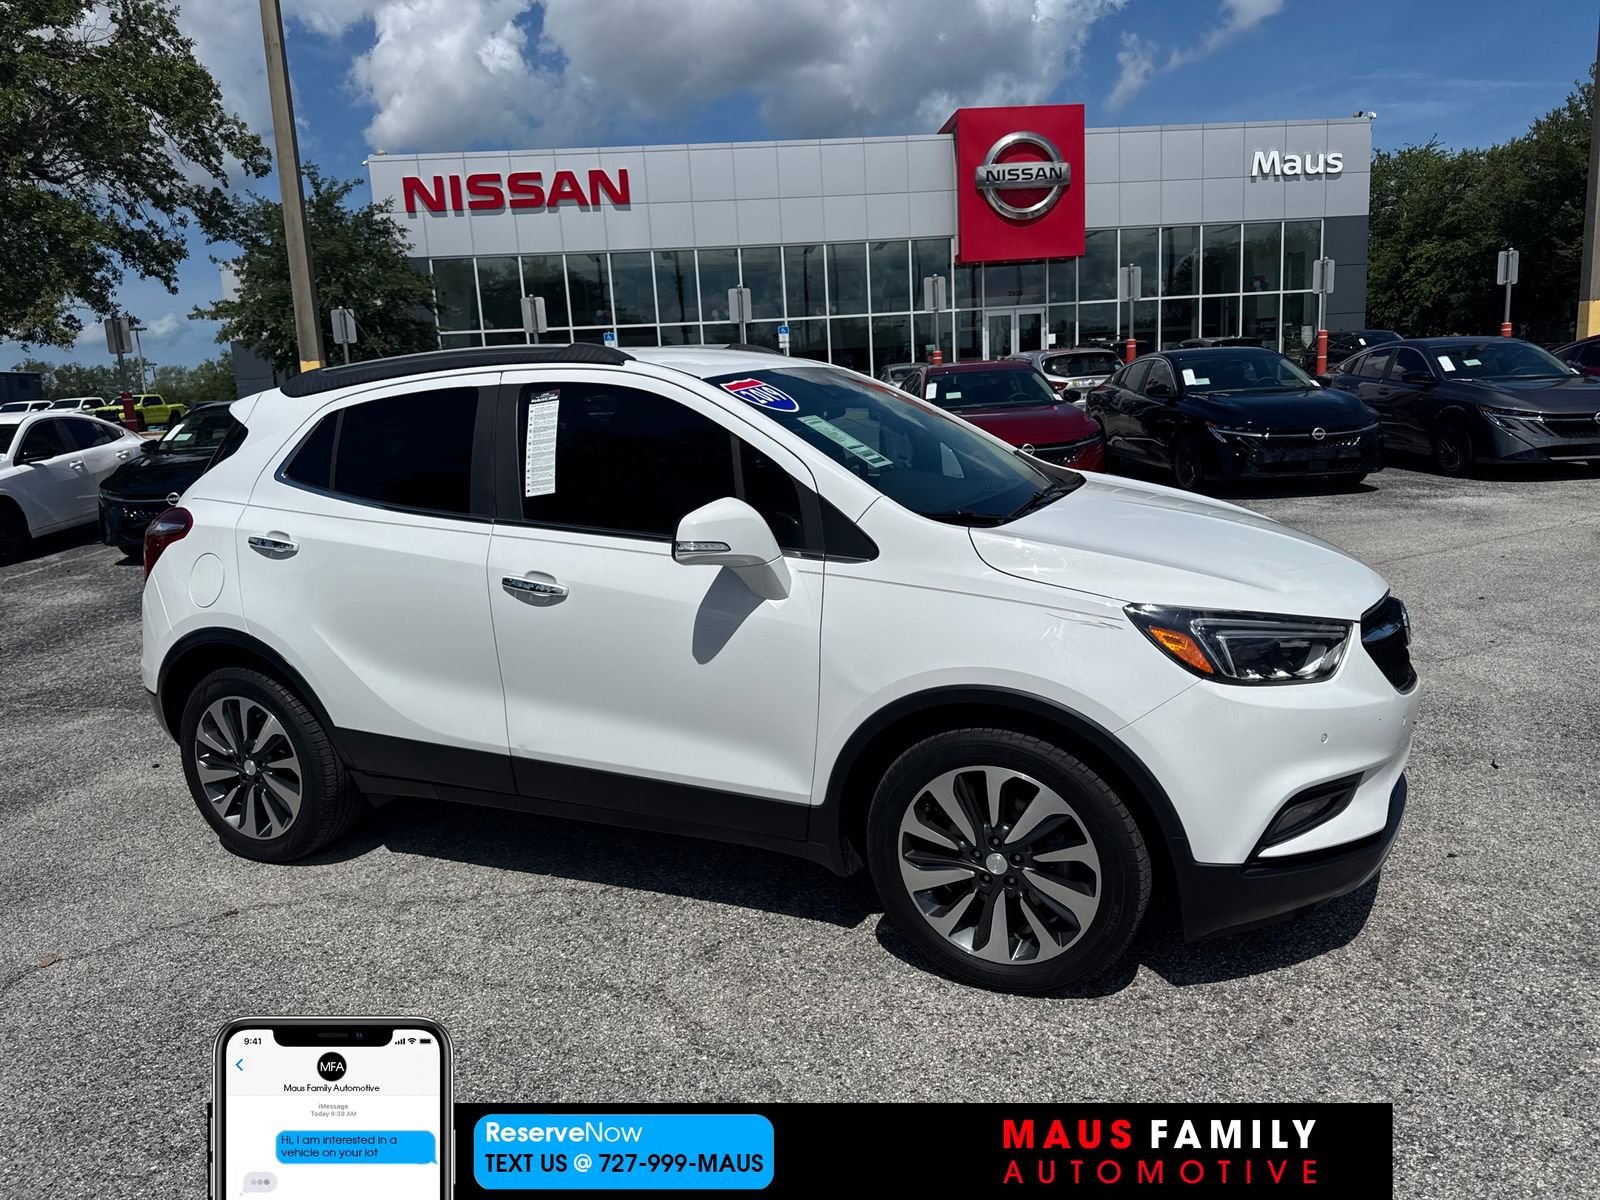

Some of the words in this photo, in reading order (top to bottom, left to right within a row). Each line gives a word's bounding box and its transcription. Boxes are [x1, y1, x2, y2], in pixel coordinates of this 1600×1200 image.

[1251, 149, 1344, 177] Maus
[985, 166, 1062, 184] NISSAN
[402, 168, 630, 213] NISSAN
[739, 386, 787, 404] 2019
